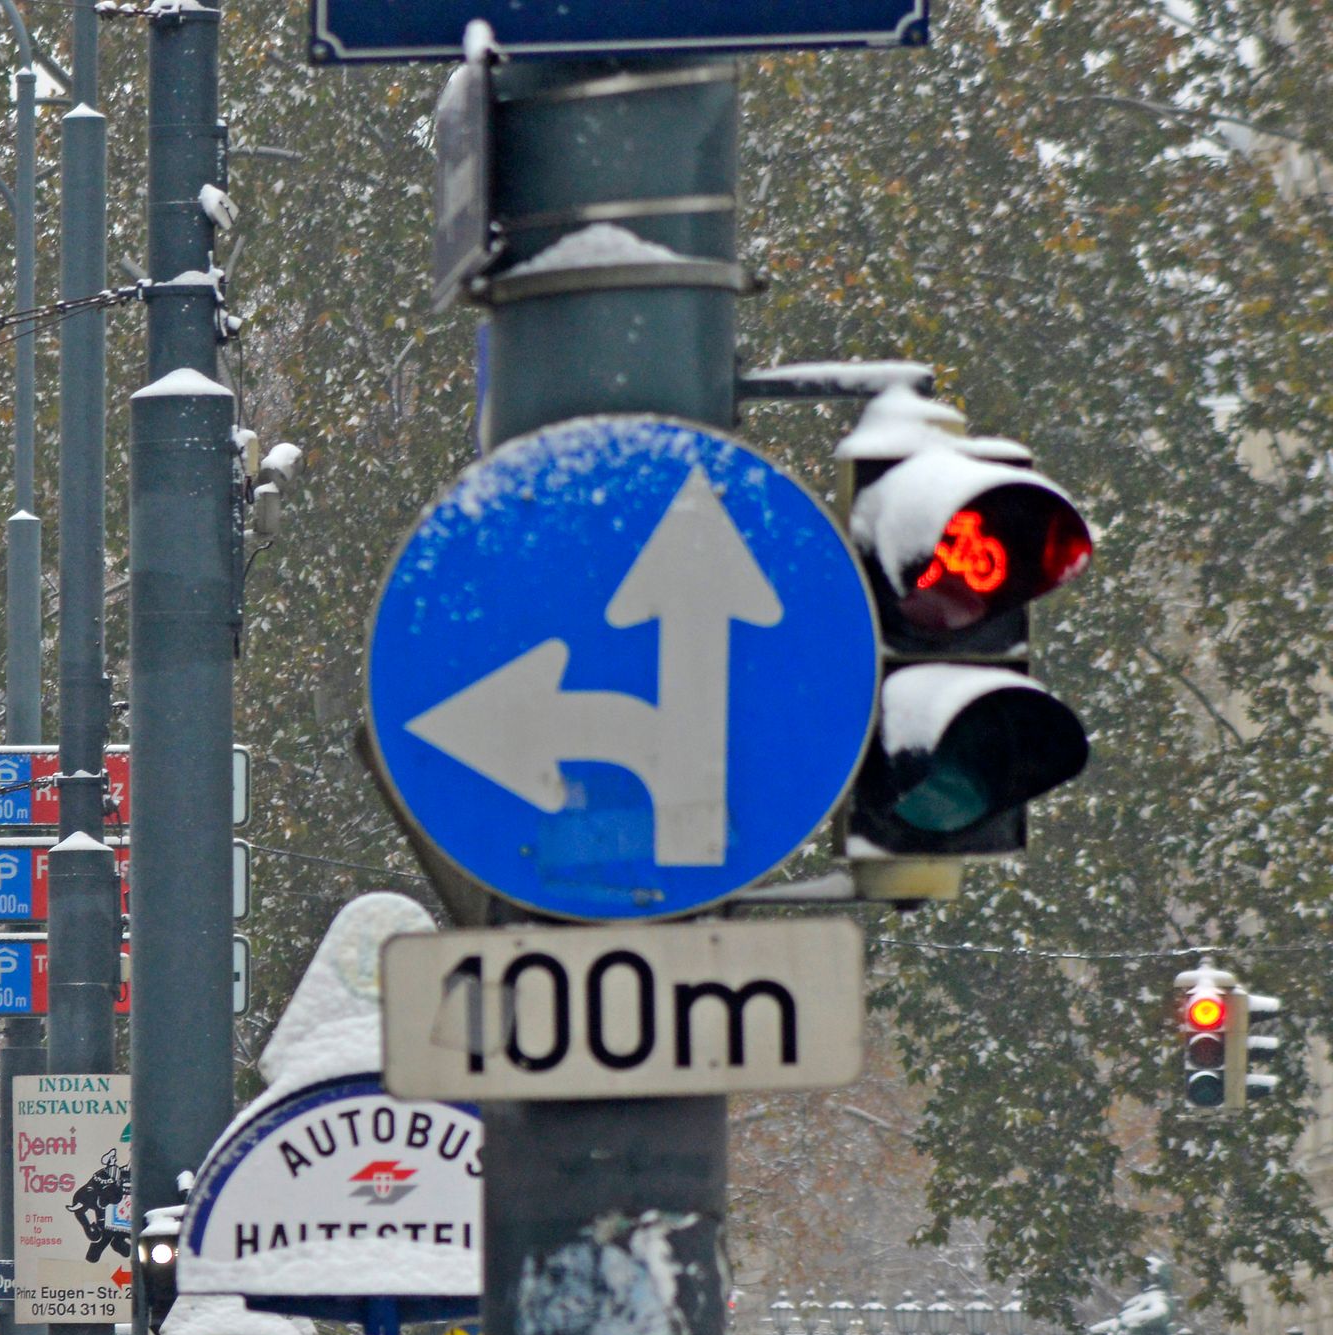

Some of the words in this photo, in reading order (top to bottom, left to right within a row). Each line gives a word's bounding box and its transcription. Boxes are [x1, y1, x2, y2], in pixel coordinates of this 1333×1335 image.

[16, 808, 28, 819] m
[17, 902, 29, 914] m
[15, 996, 27, 1008] m
[38, 1078, 111, 1093] INDIAN
[18, 1126, 77, 1162] Demi
[19, 1165, 76, 1194] Tass
[33, 1214, 54, 1223] Tram
[34, 1225, 42, 1234] to
[16, 1286, 37, 1300] Prinz
[32, 1302, 76, 1317] 01/504
